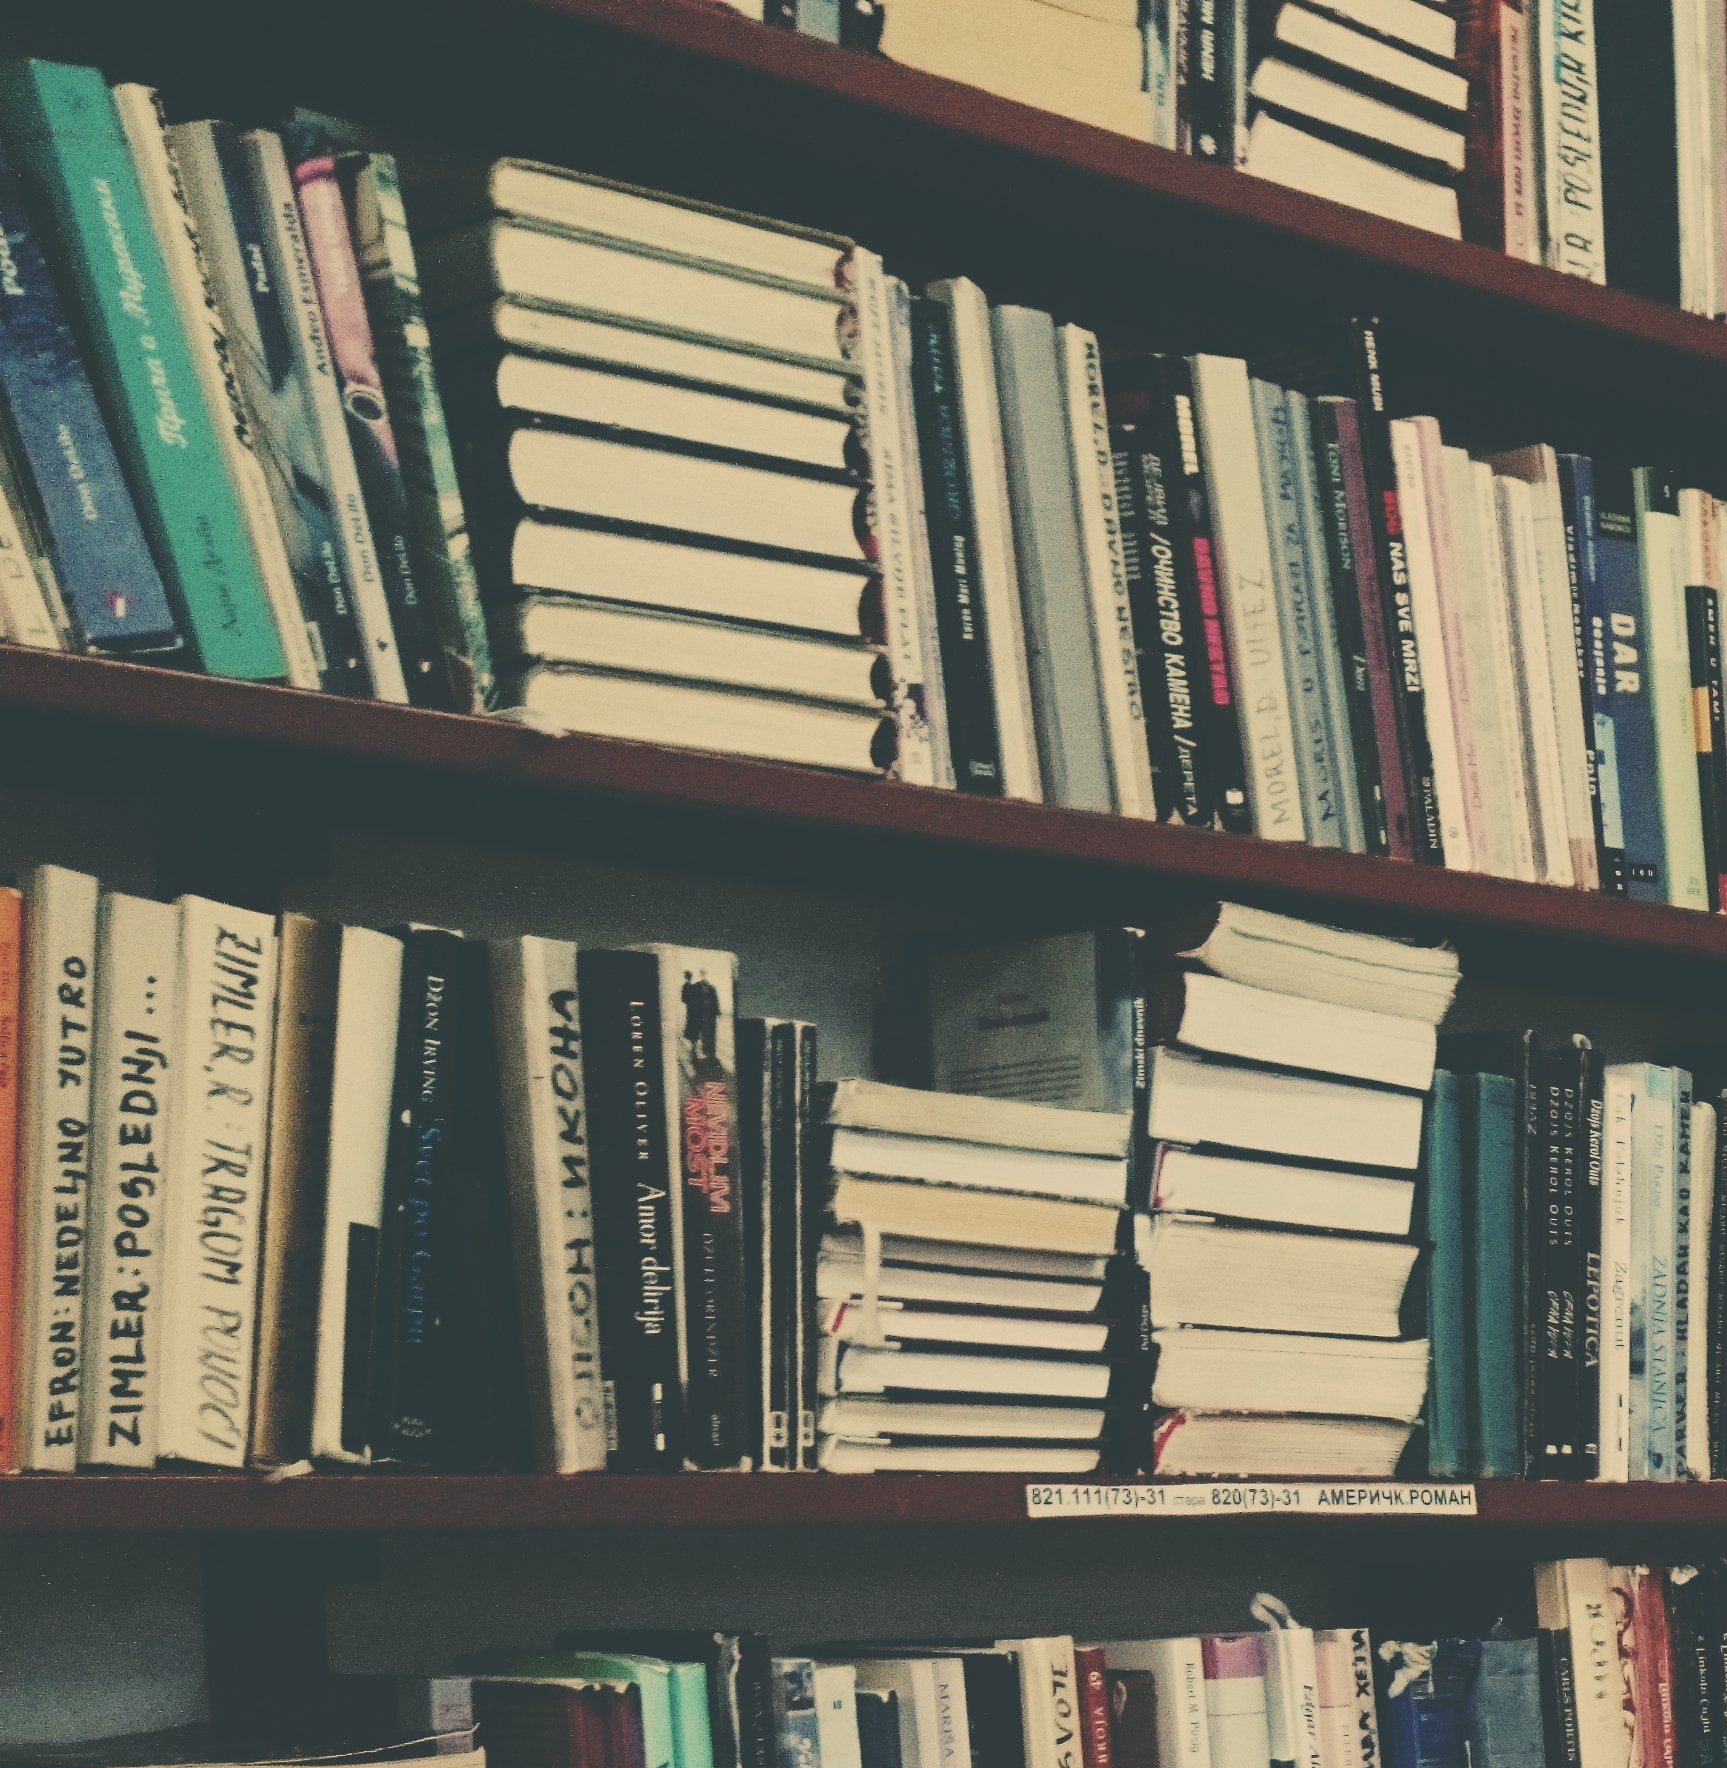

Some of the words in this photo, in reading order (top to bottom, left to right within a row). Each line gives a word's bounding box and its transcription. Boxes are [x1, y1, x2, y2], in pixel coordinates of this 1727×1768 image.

[1386, 541, 1407, 586] NAS
[1394, 590, 1413, 632] SVE
[1400, 638, 1422, 694] MRZI
[1604, 610, 1643, 697] DAR
[1162, 650, 1194, 729] КАМЕНА
[628, 1000, 648, 1070] LOREN
[549, 988, 587, 1188] ИКОНА
[632, 1080, 651, 1161] OLIVER
[199, 1138, 253, 1287] TRAGOM
[635, 1181, 668, 1252] Amor
[631, 1255, 671, 1336] delirija
[1032, 1487, 1166, 1509] 821.111(73)-31
[1212, 1488, 1301, 1509] 820(73)-31
[1088, 1669, 1103, 1690] 49
[1090, 1704, 1107, 1762] BROJA
